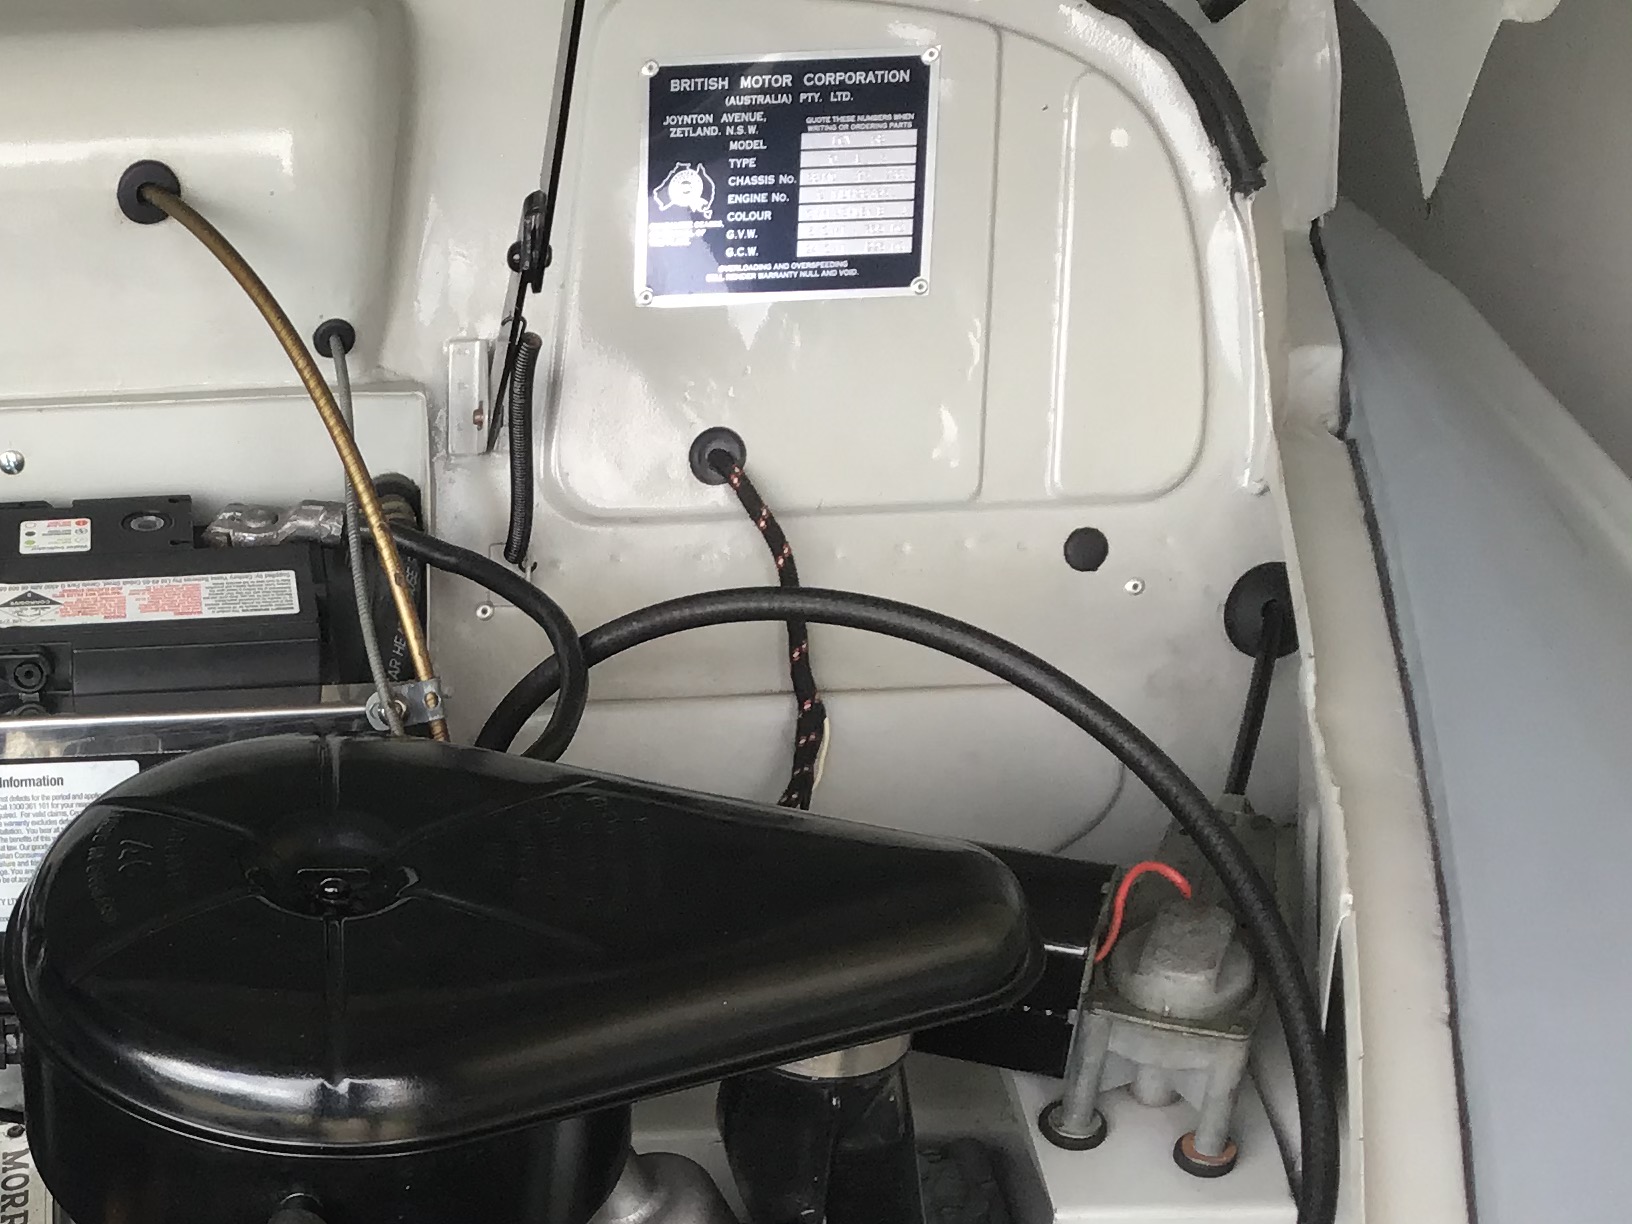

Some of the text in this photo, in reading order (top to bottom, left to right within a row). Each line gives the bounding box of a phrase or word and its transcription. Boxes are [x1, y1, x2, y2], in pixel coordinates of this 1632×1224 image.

[670, 69, 911, 92] BRITISH MOTOR CORPORATION
[724, 91, 854, 107] (AUSTRALIA) PTY. LTD.
[663, 111, 767, 126] JOYNTON AVENUE,
[726, 124, 759, 136] N.S.W.
[889, 121, 913, 129] PARTS
[729, 139, 767, 151] MODEL
[728, 157, 757, 168] TYPE
[728, 175, 776, 187] CHASSIS
[727, 193, 769, 204] ENGINE
[726, 210, 773, 222] COLOUR
[725, 228, 759, 240] G.V.W.
[725, 246, 759, 258] G.C.W.
[0, 775, 64, 788] Information
